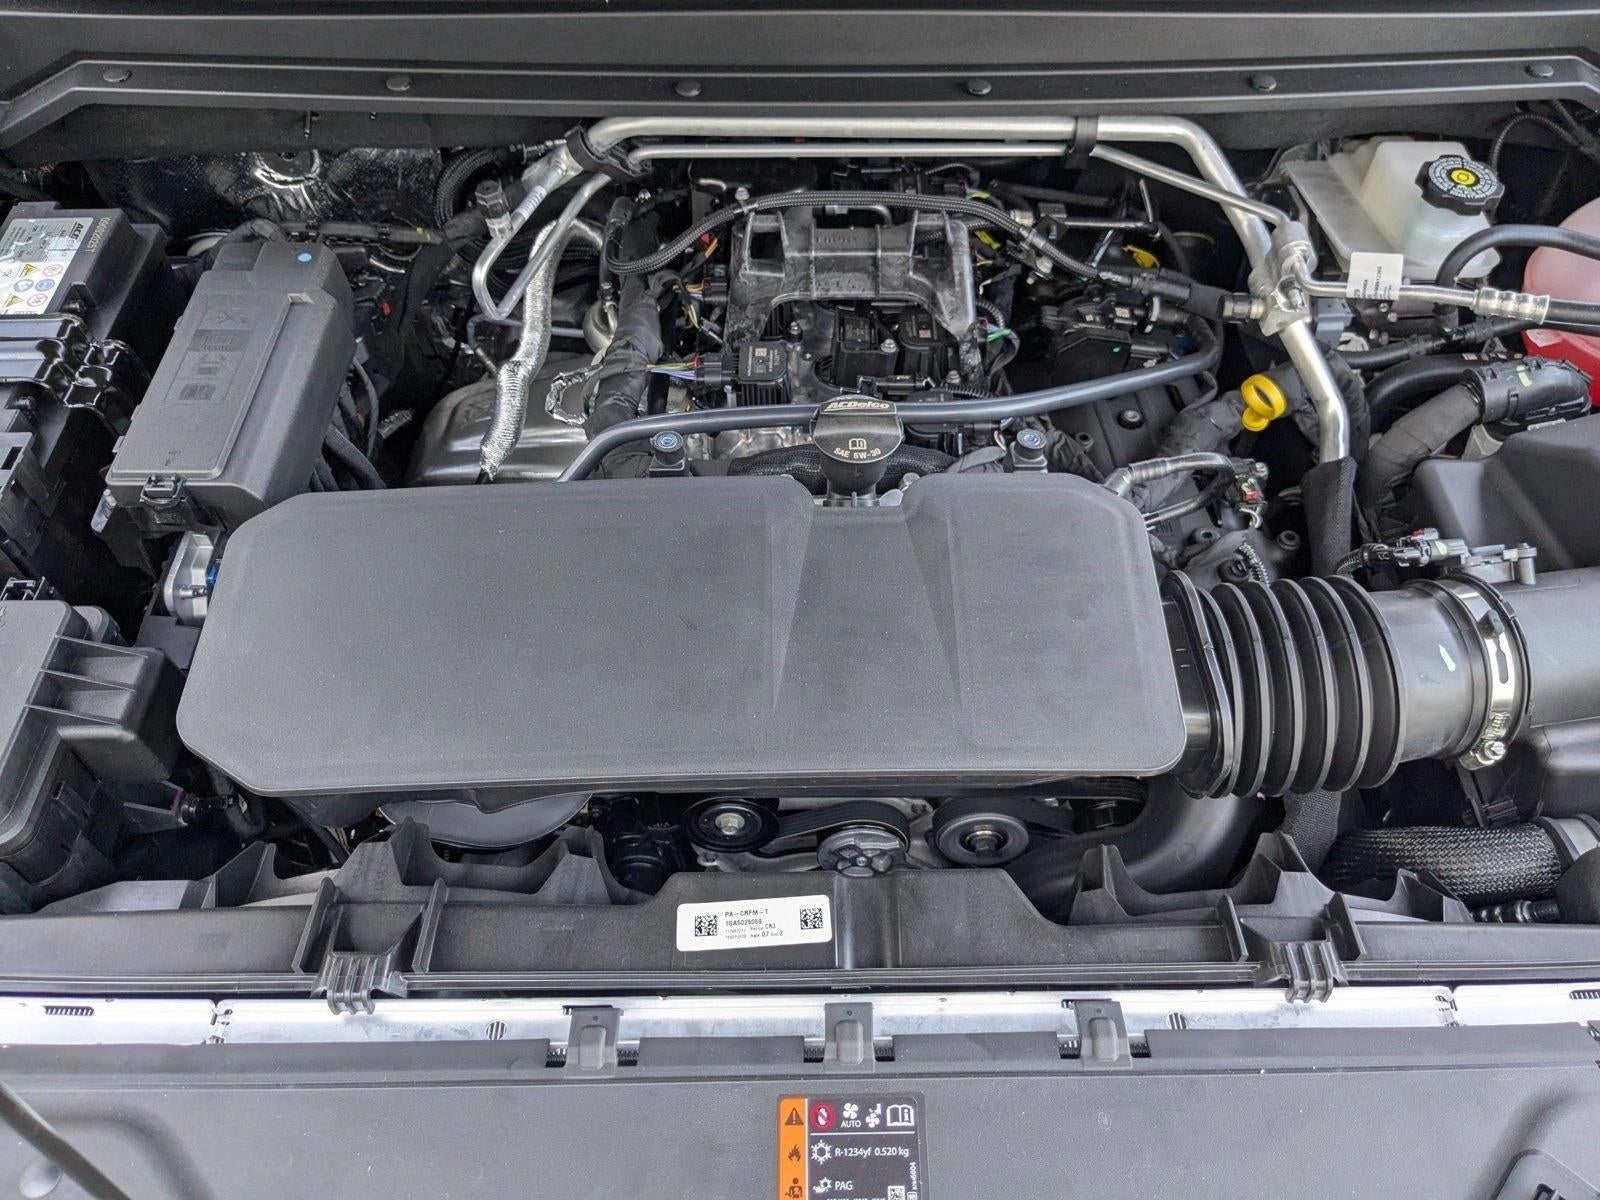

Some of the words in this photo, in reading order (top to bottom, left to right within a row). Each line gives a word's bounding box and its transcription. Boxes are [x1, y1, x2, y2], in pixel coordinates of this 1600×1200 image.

[825, 401, 890, 411] ACDelco
[833, 447, 851, 458] SAE
[853, 447, 882, 459] 5W-30
[840, 1120, 862, 1129] AUTO
[834, 1146, 872, 1159] R-1234yf
[874, 1147, 897, 1157] 0.520
[898, 1146, 910, 1158] kg
[834, 1181, 854, 1191] PAG
